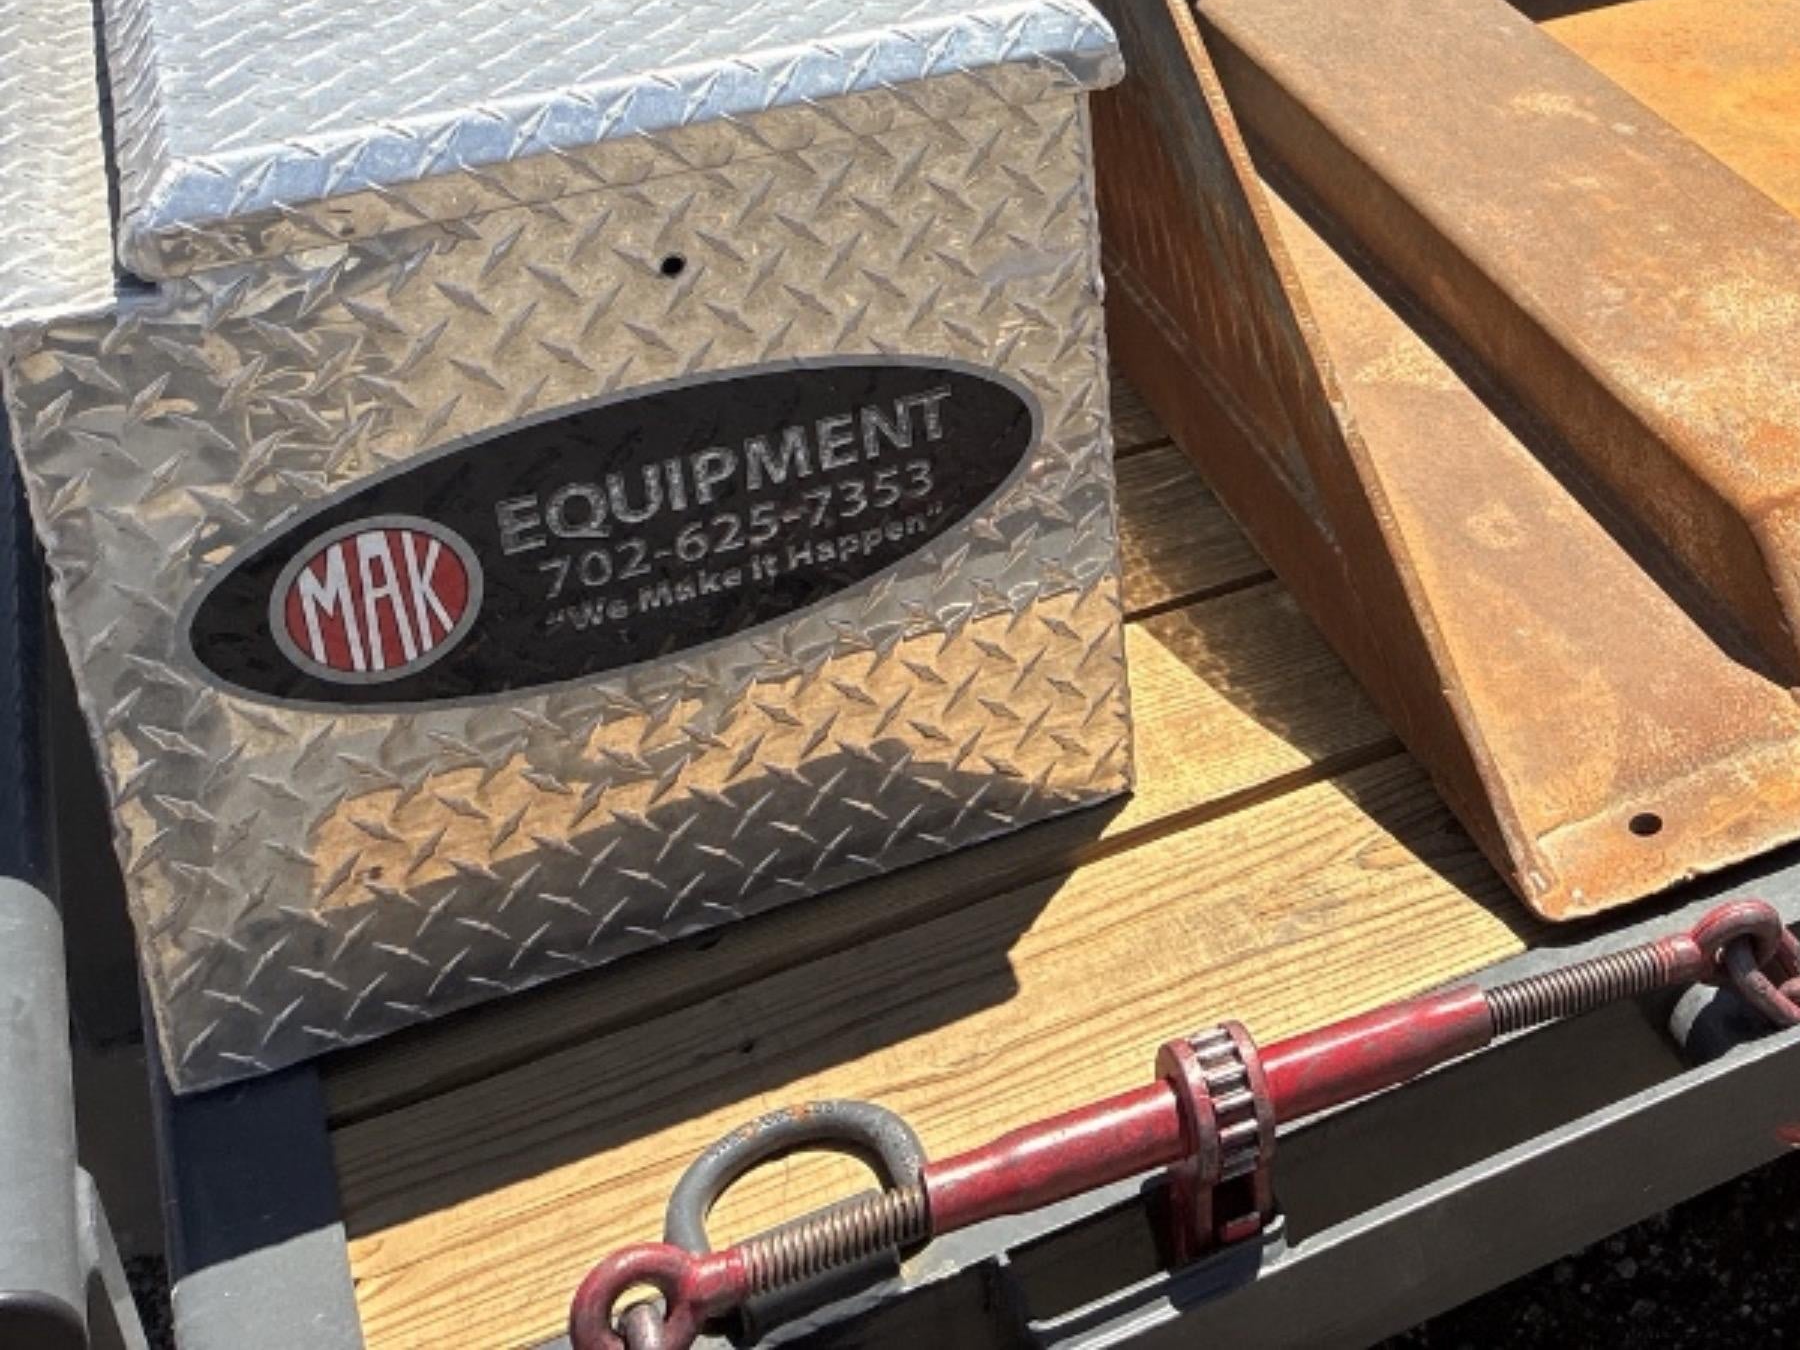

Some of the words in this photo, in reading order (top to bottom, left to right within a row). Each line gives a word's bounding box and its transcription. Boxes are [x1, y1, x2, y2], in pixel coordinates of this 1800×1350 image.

[498, 384, 952, 556] EQUIPMENT
[539, 458, 936, 600] 702-625-7353
[297, 530, 455, 672] MAK
[638, 564, 743, 612] Make
